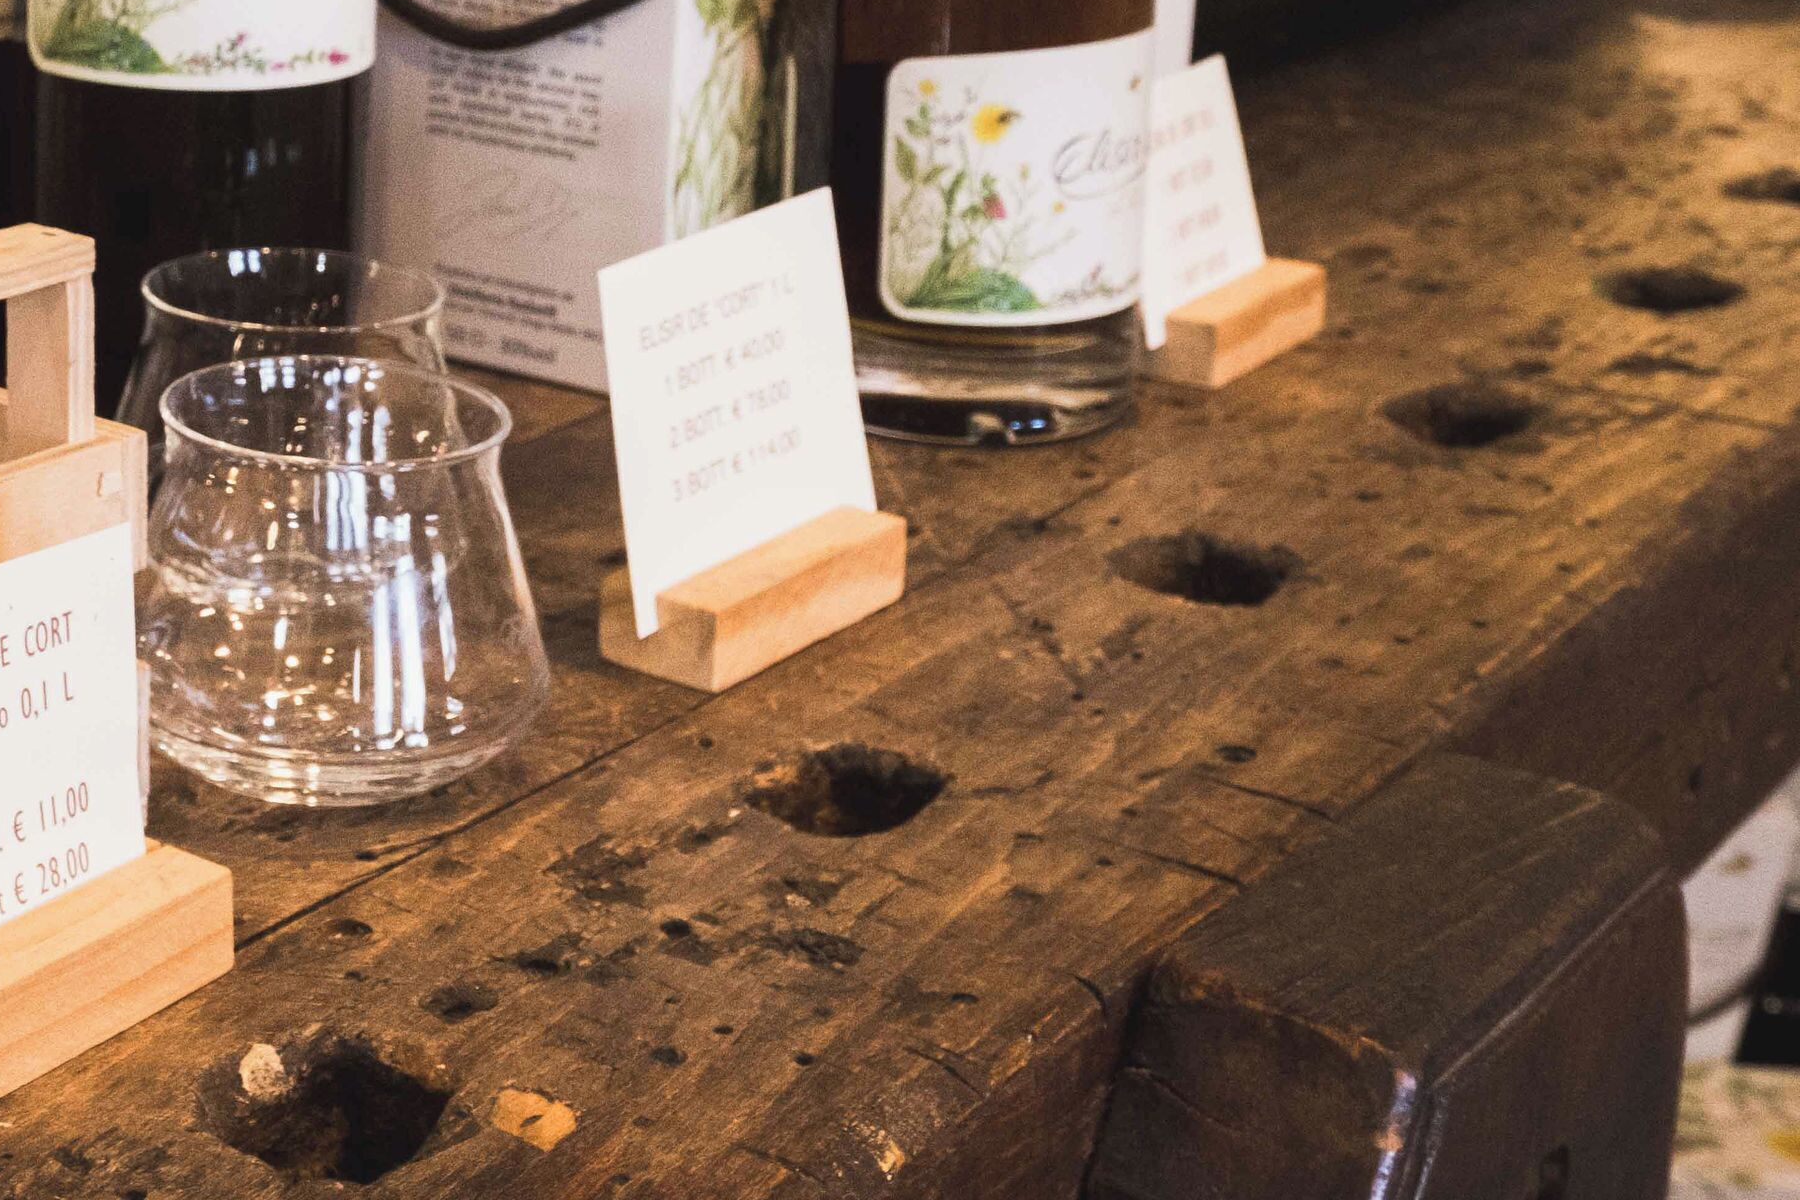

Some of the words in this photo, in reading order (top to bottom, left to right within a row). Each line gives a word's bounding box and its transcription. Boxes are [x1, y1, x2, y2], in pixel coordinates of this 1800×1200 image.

[24, 611, 73, 657] CORT
[20, 679, 49, 720] 0,1
[63, 671, 74, 702] L
[13, 810, 27, 842] €
[14, 872, 28, 904] €
